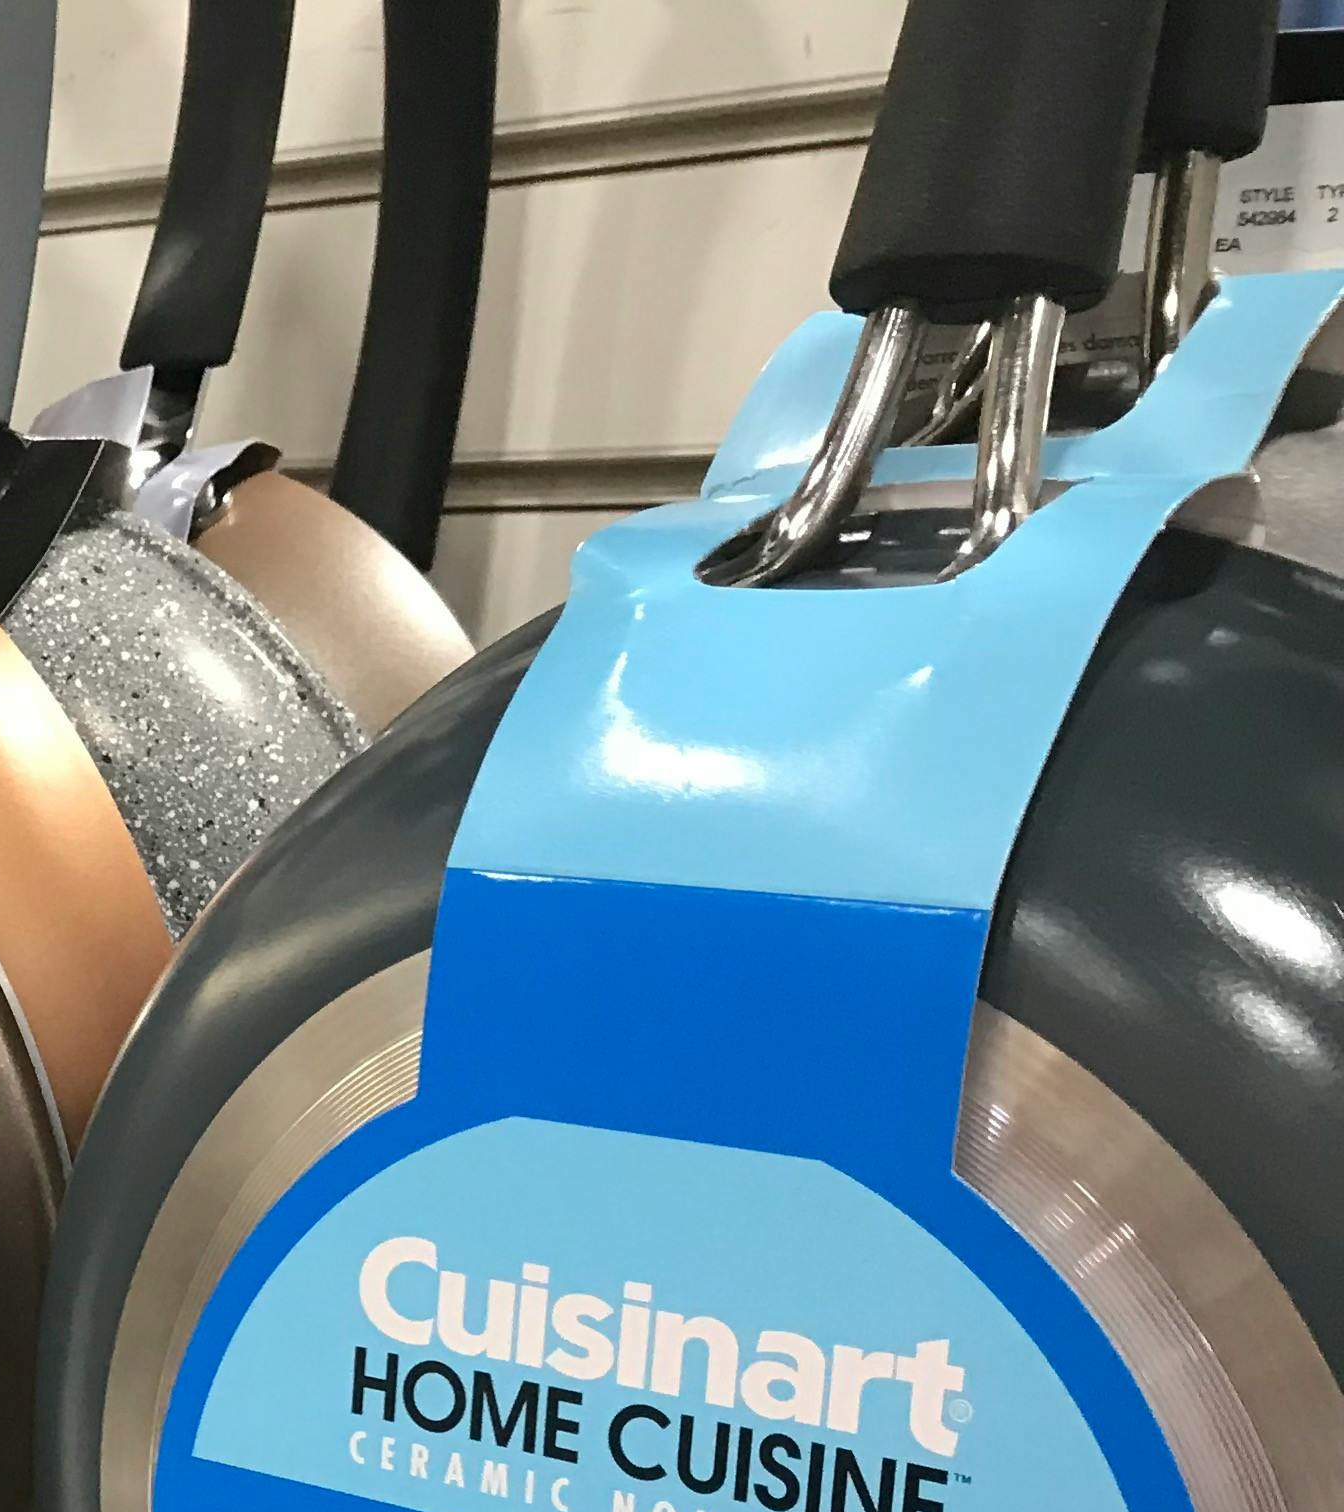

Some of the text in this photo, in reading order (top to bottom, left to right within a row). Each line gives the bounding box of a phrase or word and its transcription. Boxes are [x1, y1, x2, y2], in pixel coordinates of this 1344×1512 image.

[1240, 184, 1344, 204] STYLE TYP
[1326, 206, 1339, 223] 2
[1215, 237, 1242, 253] EA
[359, 1236, 966, 1458] Cuisinart
[350, 1346, 585, 1464] HOME
[349, 1430, 571, 1512] CERAMIC
